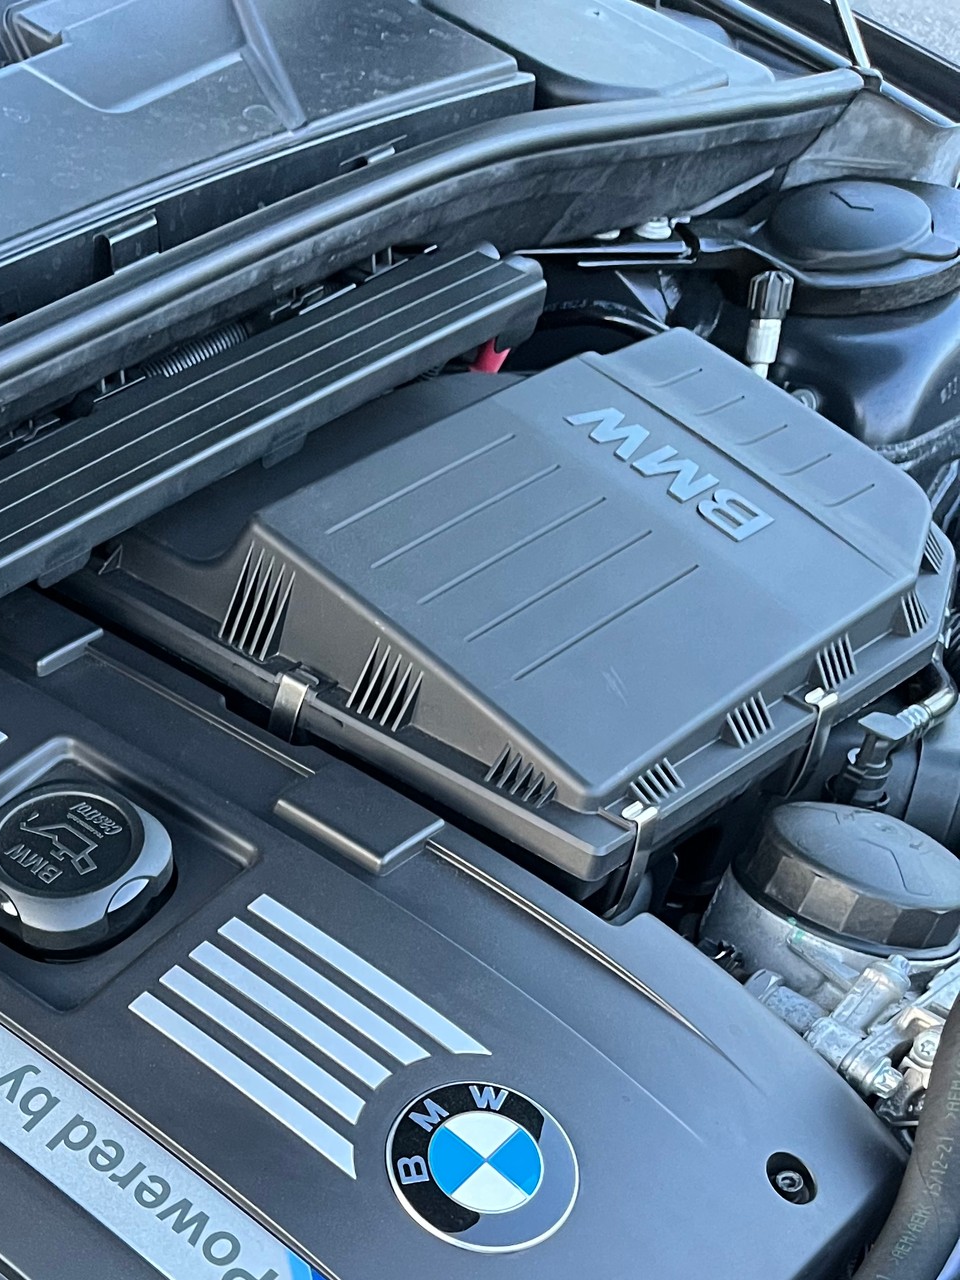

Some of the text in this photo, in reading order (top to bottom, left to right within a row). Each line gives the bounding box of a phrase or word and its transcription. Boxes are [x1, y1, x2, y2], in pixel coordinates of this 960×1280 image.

[562, 407, 775, 543] BMW
[69, 802, 123, 835] Castrol
[4, 844, 63, 884] BMW
[397, 1085, 509, 1185] BMW
